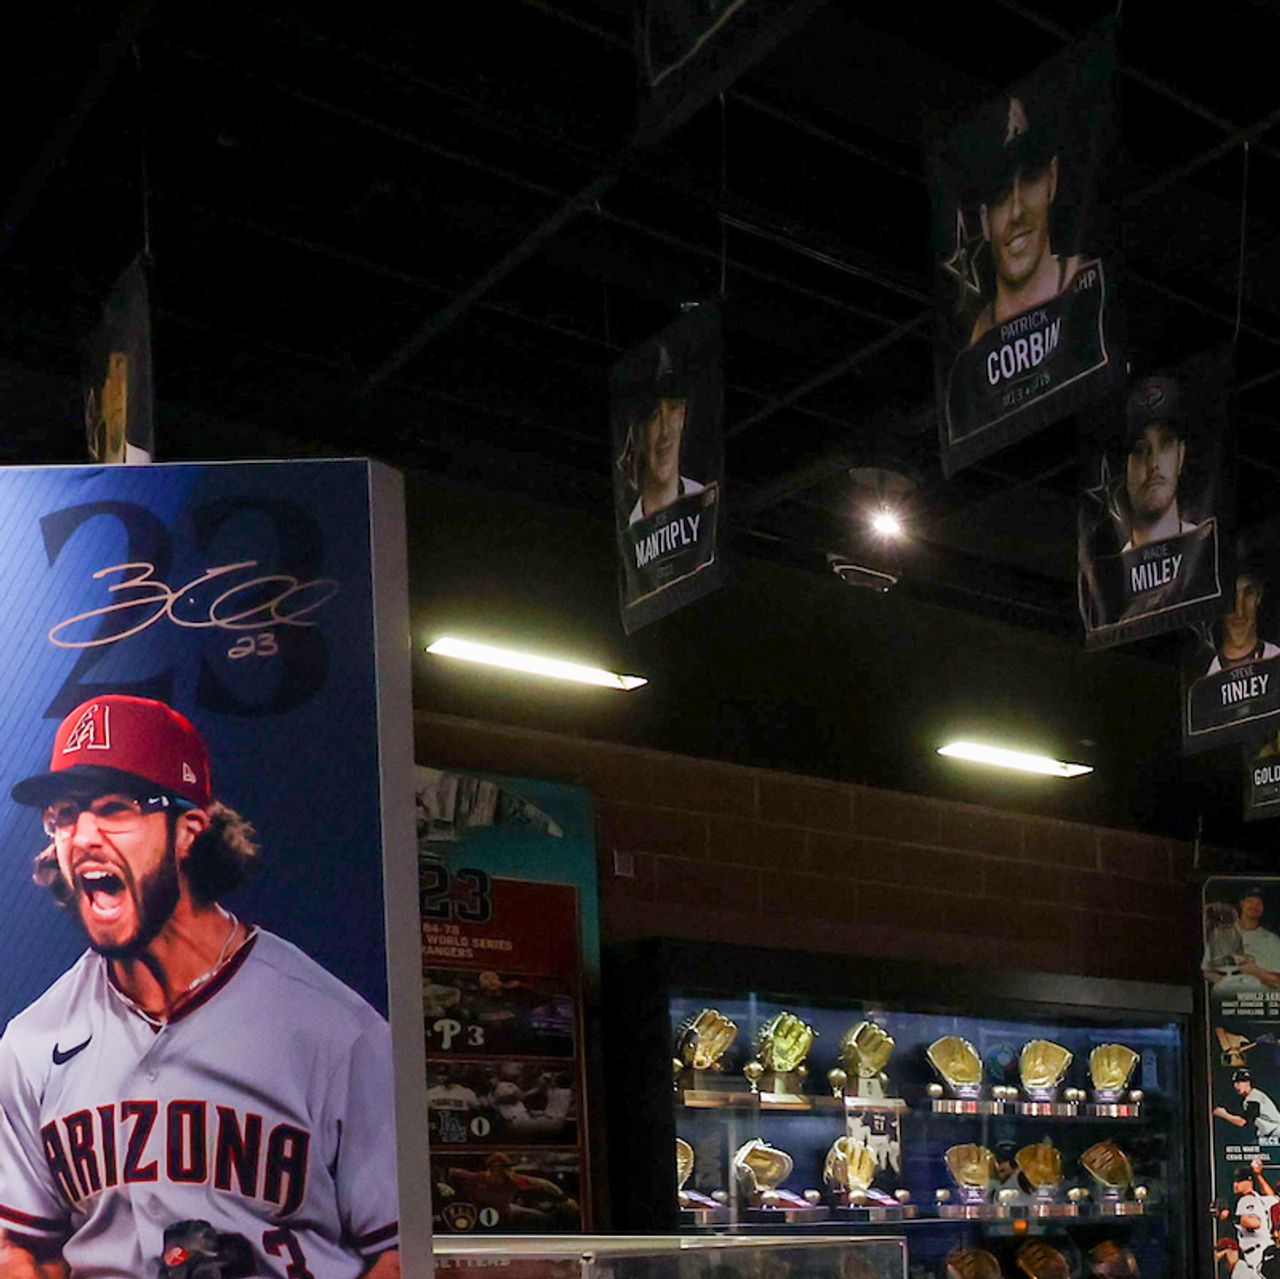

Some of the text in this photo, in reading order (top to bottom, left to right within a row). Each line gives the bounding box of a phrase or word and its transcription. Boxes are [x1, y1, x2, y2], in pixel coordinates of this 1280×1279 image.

[1001, 310, 1049, 341] PATRICK
[986, 316, 1062, 386] CORBIN
[635, 514, 701, 569] MANTIPLY
[1130, 554, 1183, 592] MILEY
[41, 501, 330, 718] 23
[227, 632, 279, 659] 23
[1220, 674, 1270, 705] FINLEY
[418, 863, 492, 923] 23
[424, 947, 474, 957] ANGERS
[428, 935, 514, 951] WORLD SERIES
[41, 1100, 311, 1219] ARIZONA
